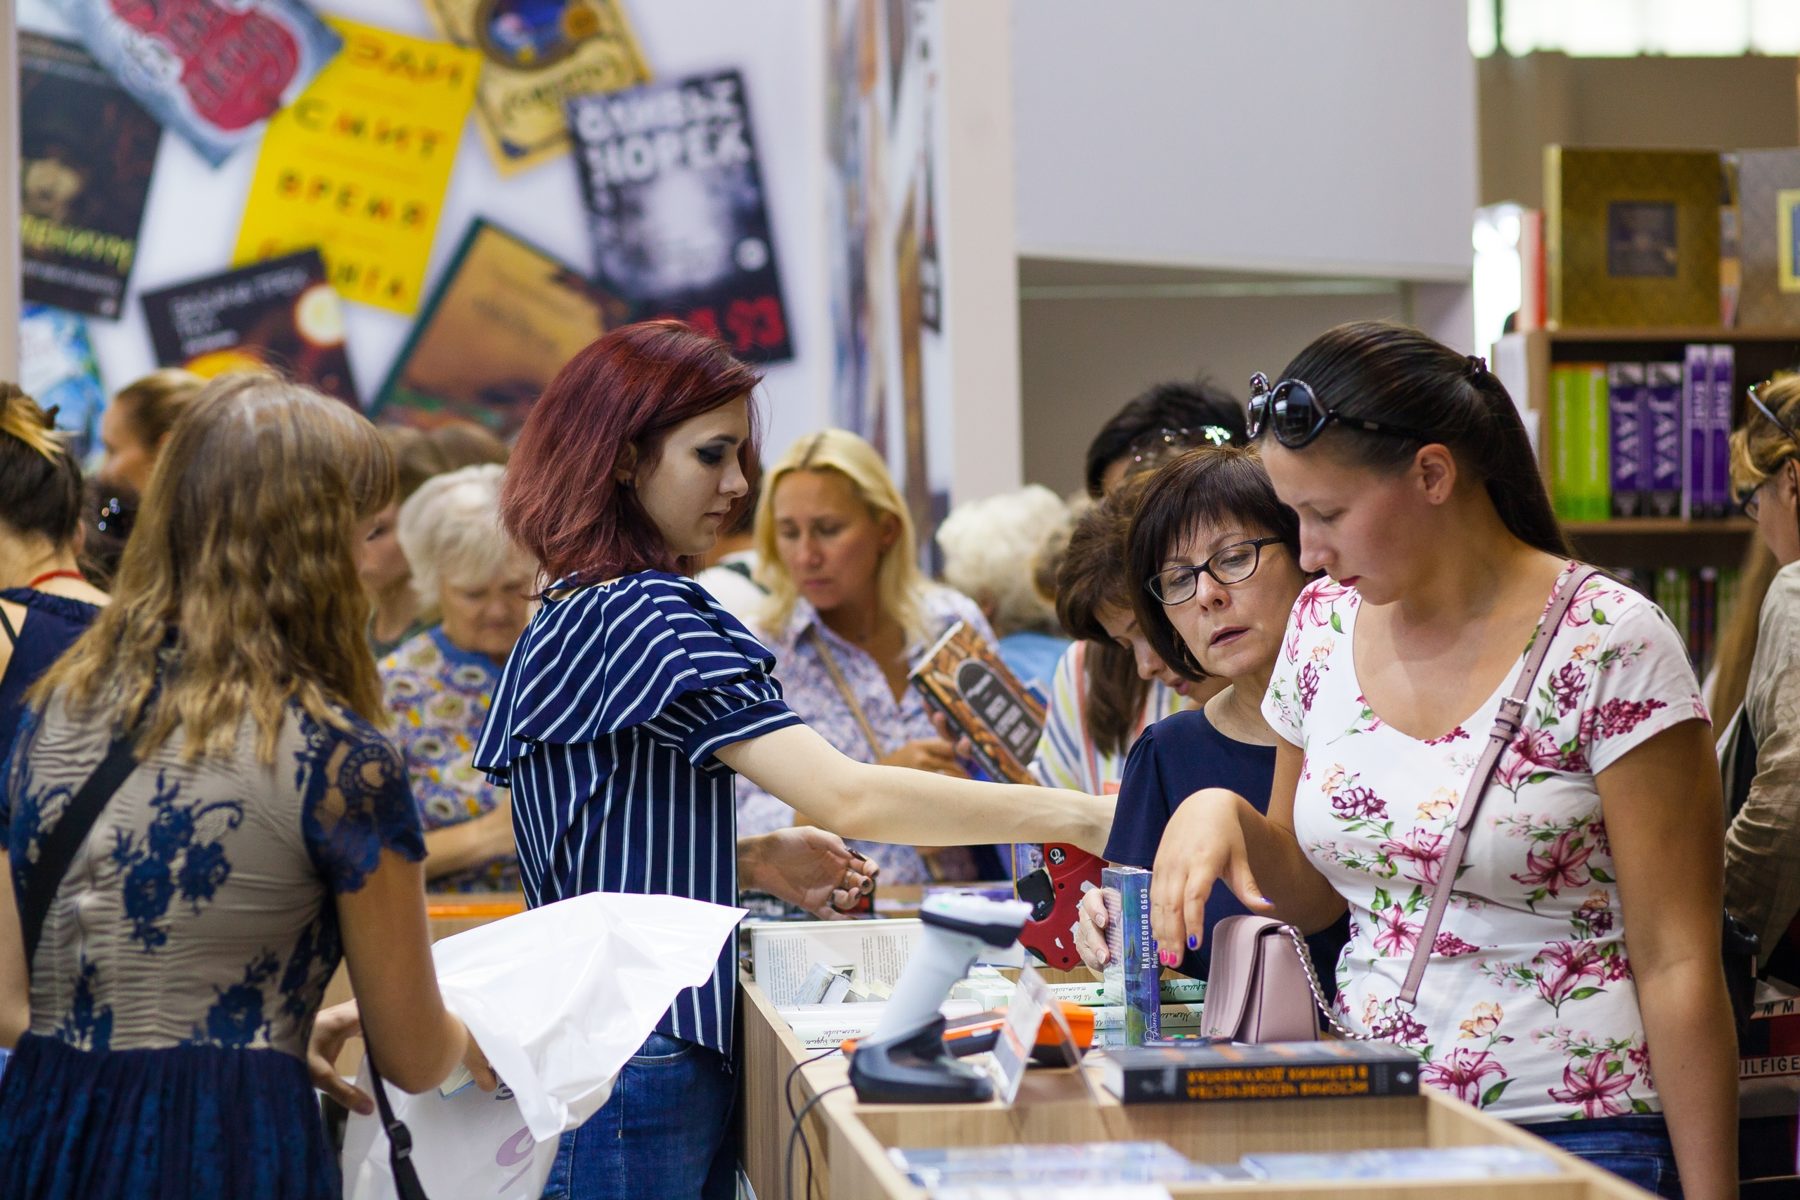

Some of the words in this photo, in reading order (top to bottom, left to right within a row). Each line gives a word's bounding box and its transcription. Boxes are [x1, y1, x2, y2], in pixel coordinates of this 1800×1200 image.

[1140, 888, 1148, 910] ОБОЗ
[1141, 913, 1150, 969] НАПОЛЕОНОВ
[1740, 1056, 1800, 1075] ILFIGE
